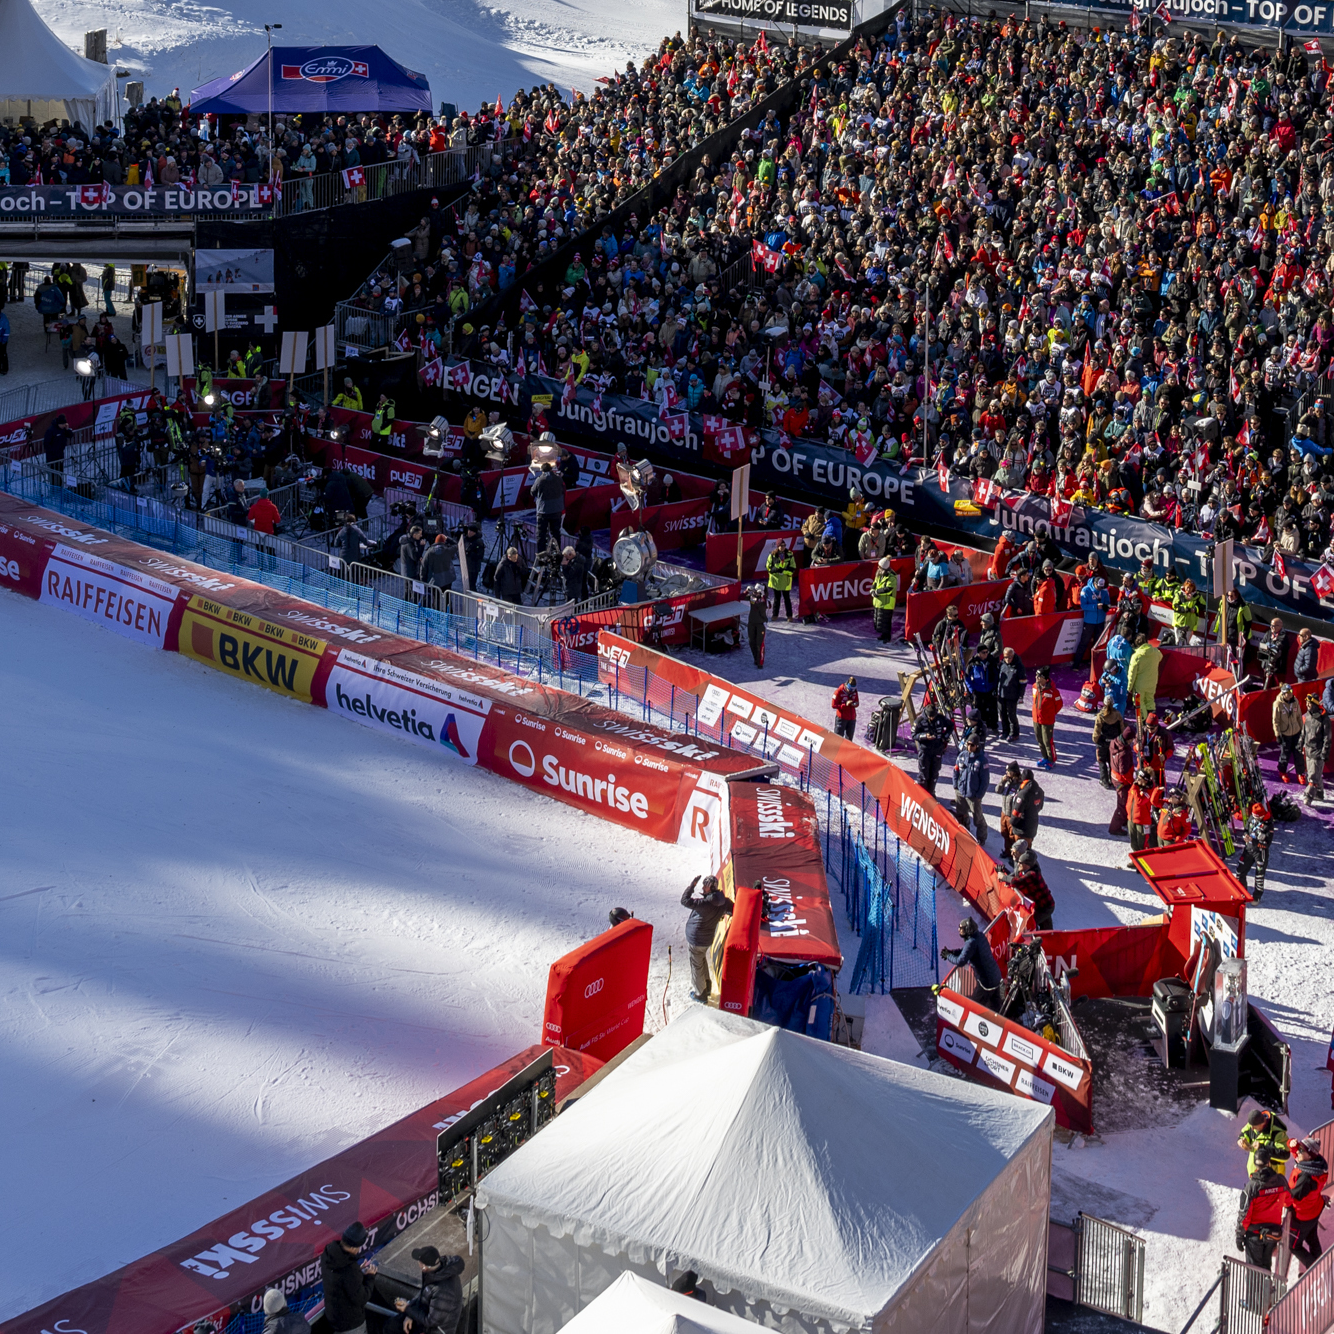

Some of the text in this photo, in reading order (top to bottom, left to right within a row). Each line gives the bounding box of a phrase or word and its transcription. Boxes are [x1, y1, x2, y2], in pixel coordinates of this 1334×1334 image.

[764, 0, 783, 16] OF
[786, 3, 848, 23] LEGENDS
[1246, 0, 1287, 20] TOP
[1294, 5, 1326, 26] OF
[305, 65, 349, 75] Emmi
[123, 190, 156, 210] OF
[332, 457, 376, 481] swissski
[772, 448, 806, 474] OF
[813, 458, 916, 506] EUROPE
[19, 515, 109, 545] swissski
[19, 532, 36, 545] Sunrise
[60, 548, 84, 561] RAIFFEISEN
[89, 559, 115, 572] RAIFFEISEN
[139, 558, 235, 592] swissski
[1195, 550, 1257, 587] TP
[1266, 570, 1310, 600] OF
[120, 569, 143, 583] RAIFFEISEN
[149, 580, 173, 595] RAIFFEISEN
[48, 570, 161, 638] RAIFFEISEN
[203, 601, 221, 615] BKW
[232, 612, 252, 627] BKW
[278, 610, 382, 644] swissski
[264, 624, 285, 638] BKW
[298, 636, 319, 650] BKW
[219, 632, 299, 692] BKW
[344, 654, 478, 707] helvetia Ihre Schweizer Versicherung helvetia
[421, 660, 534, 697] swissski
[335, 683, 436, 742] helvetia
[522, 716, 546, 732] Sunrise
[562, 729, 586, 746] Sunrise
[594, 720, 720, 761] swissski
[602, 743, 627, 760] Sunrise
[642, 757, 669, 774] Sunrise
[542, 754, 649, 819] Sunrise
[755, 787, 795, 838] swissski
[900, 793, 950, 856] WENGEN
[762, 877, 810, 937] swissski
[545, 1036, 561, 1046] Audi
[955, 1042, 971, 1054] Sunrise
[984, 1060, 1000, 1073] SPORT
[985, 1056, 1009, 1073] OCHSNER
[1058, 1064, 1074, 1079] BKW
[1021, 1077, 1049, 1097] RAIFFEISEN
[1264, 1187, 1279, 1195] ARZT
[179, 1184, 351, 1280] swissski
